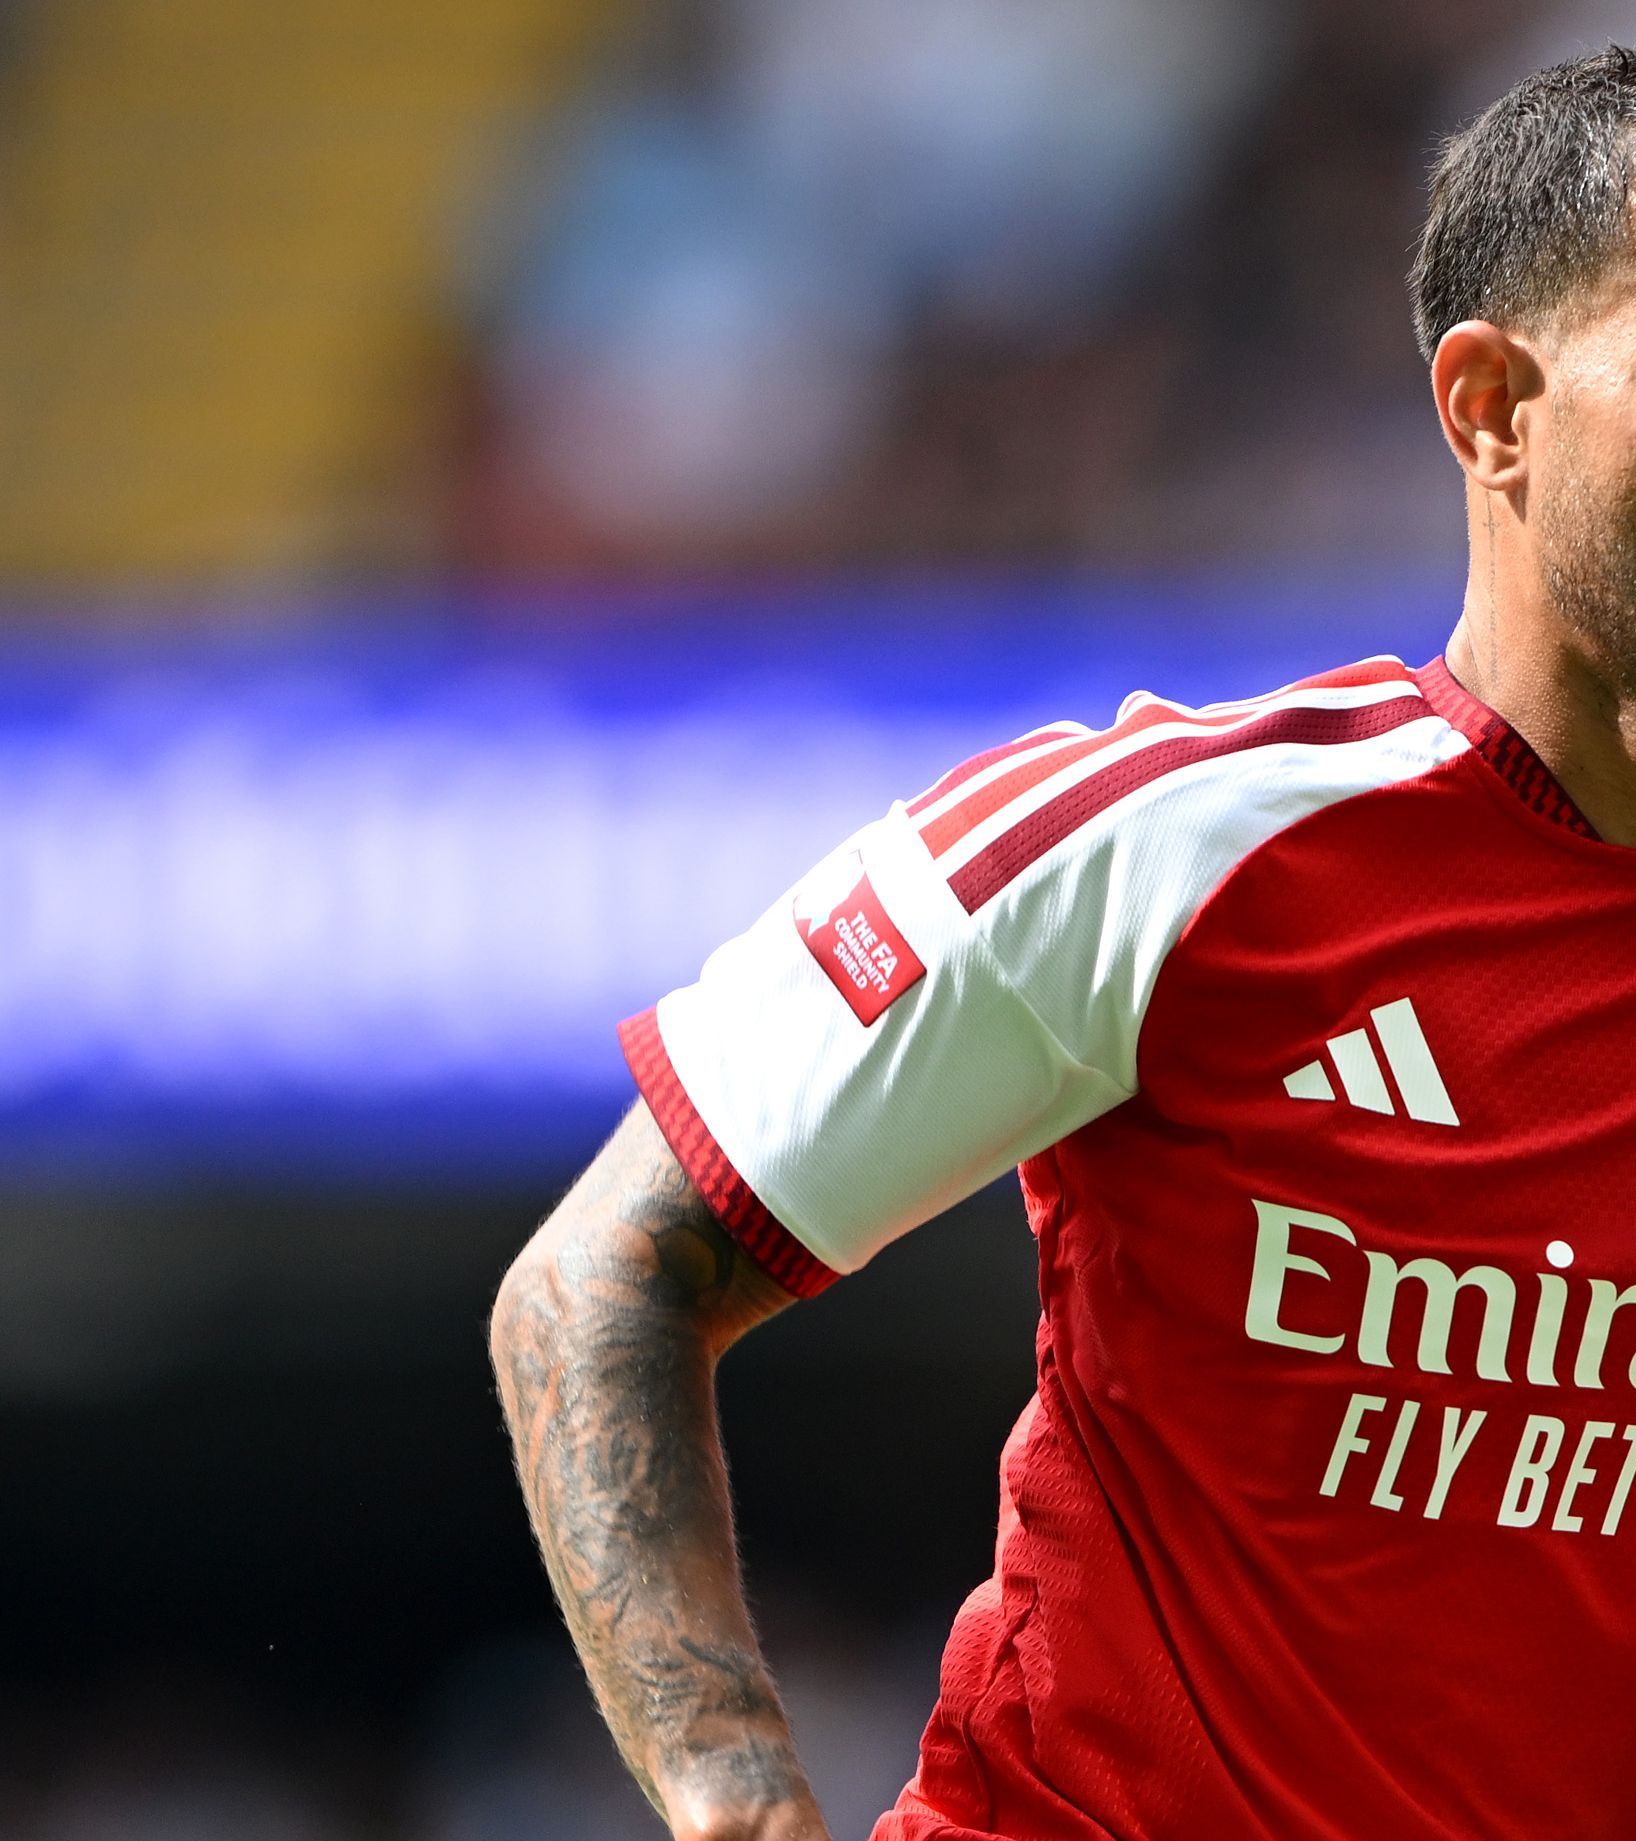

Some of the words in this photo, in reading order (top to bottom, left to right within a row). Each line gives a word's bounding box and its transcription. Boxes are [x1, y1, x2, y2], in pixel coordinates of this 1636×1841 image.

[833, 943, 868, 990] SHIELD
[834, 917, 890, 994] COMMUNITY
[850, 910, 878, 948] THE
[871, 942, 898, 979] FA
[1319, 1393, 1488, 1520] FLY
